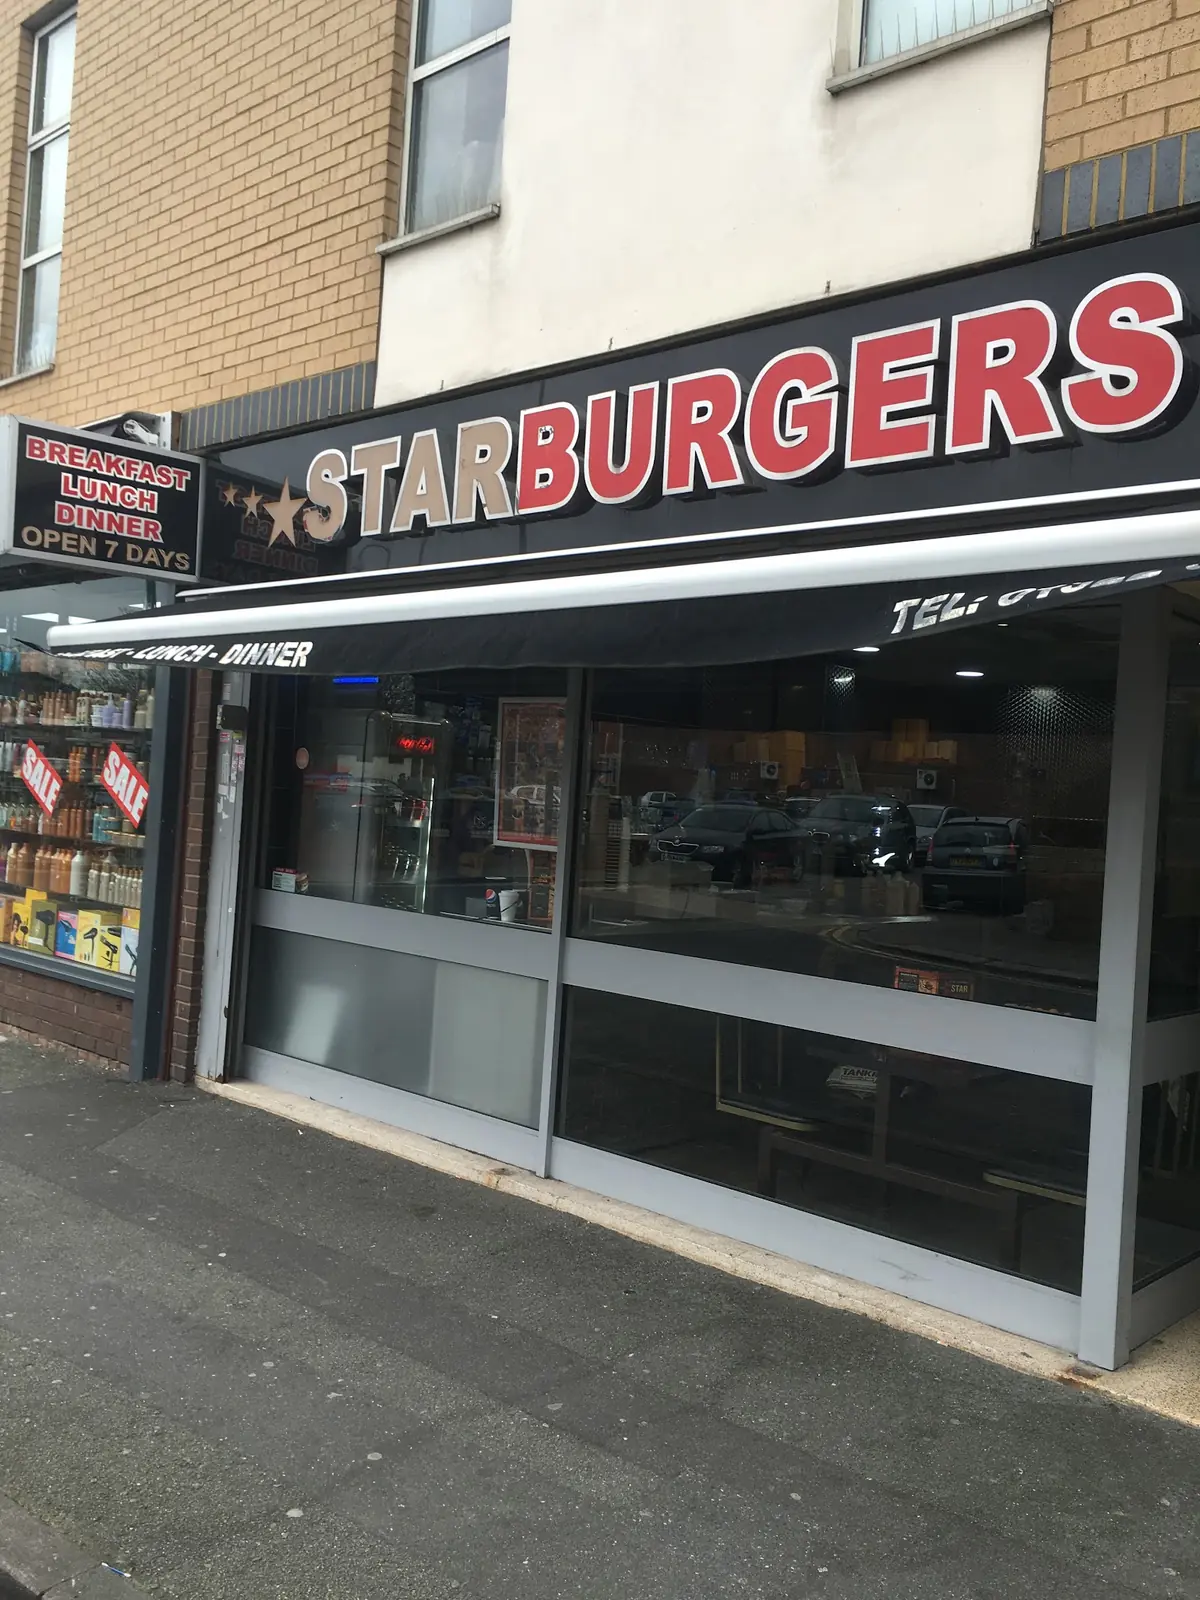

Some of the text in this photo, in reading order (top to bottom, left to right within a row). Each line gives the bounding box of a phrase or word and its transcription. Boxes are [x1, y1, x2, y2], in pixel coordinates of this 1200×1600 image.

[26, 434, 191, 491] BREAKFAST
[60, 472, 158, 514] LUNCH
[54, 501, 164, 543] DINNER
[21, 525, 190, 571] OPEN 7 DAYS
[219, 641, 314, 668] DINNER
[22, 746, 61, 814] SALE
[103, 750, 149, 824] SALE
[950, 983, 969, 993] STAR
